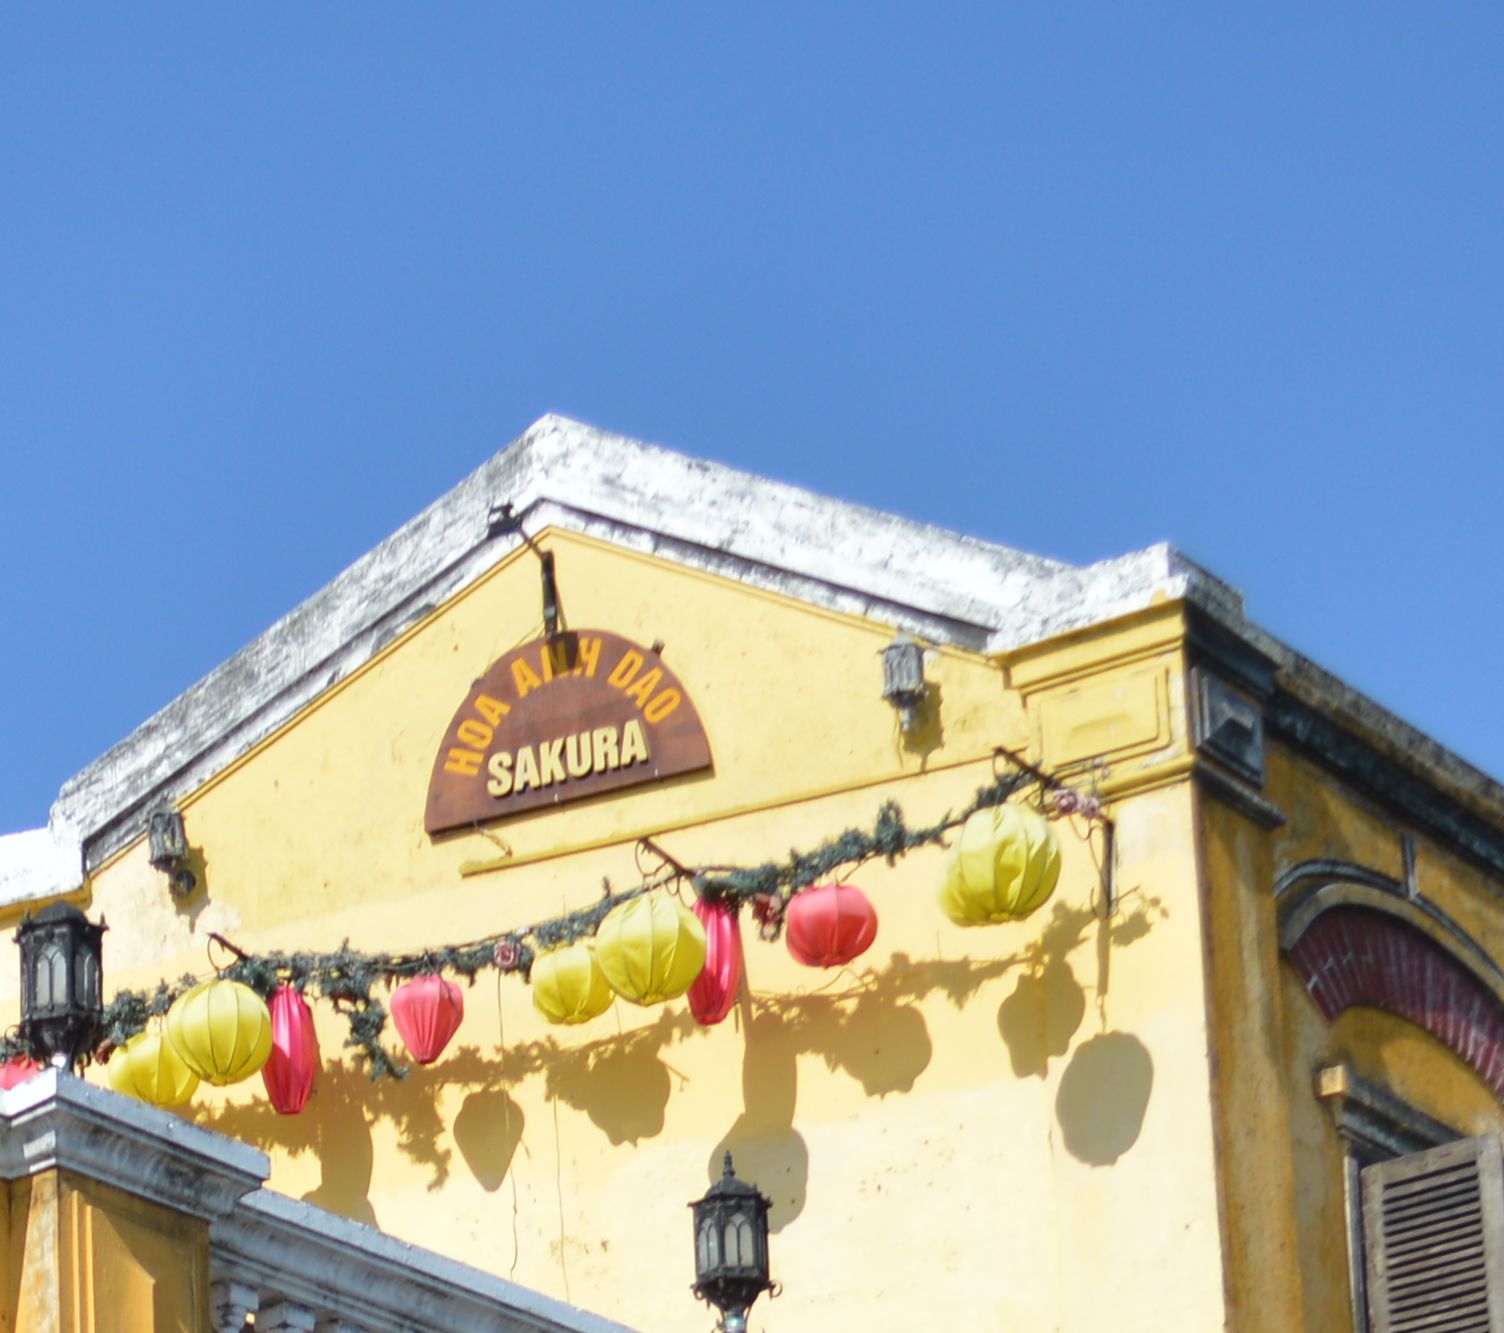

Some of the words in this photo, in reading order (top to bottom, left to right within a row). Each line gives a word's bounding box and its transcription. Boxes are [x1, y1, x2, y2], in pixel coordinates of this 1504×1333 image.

[445, 693, 512, 777] HOA
[509, 638, 603, 698] ANH
[487, 718, 649, 798] SAKURA
